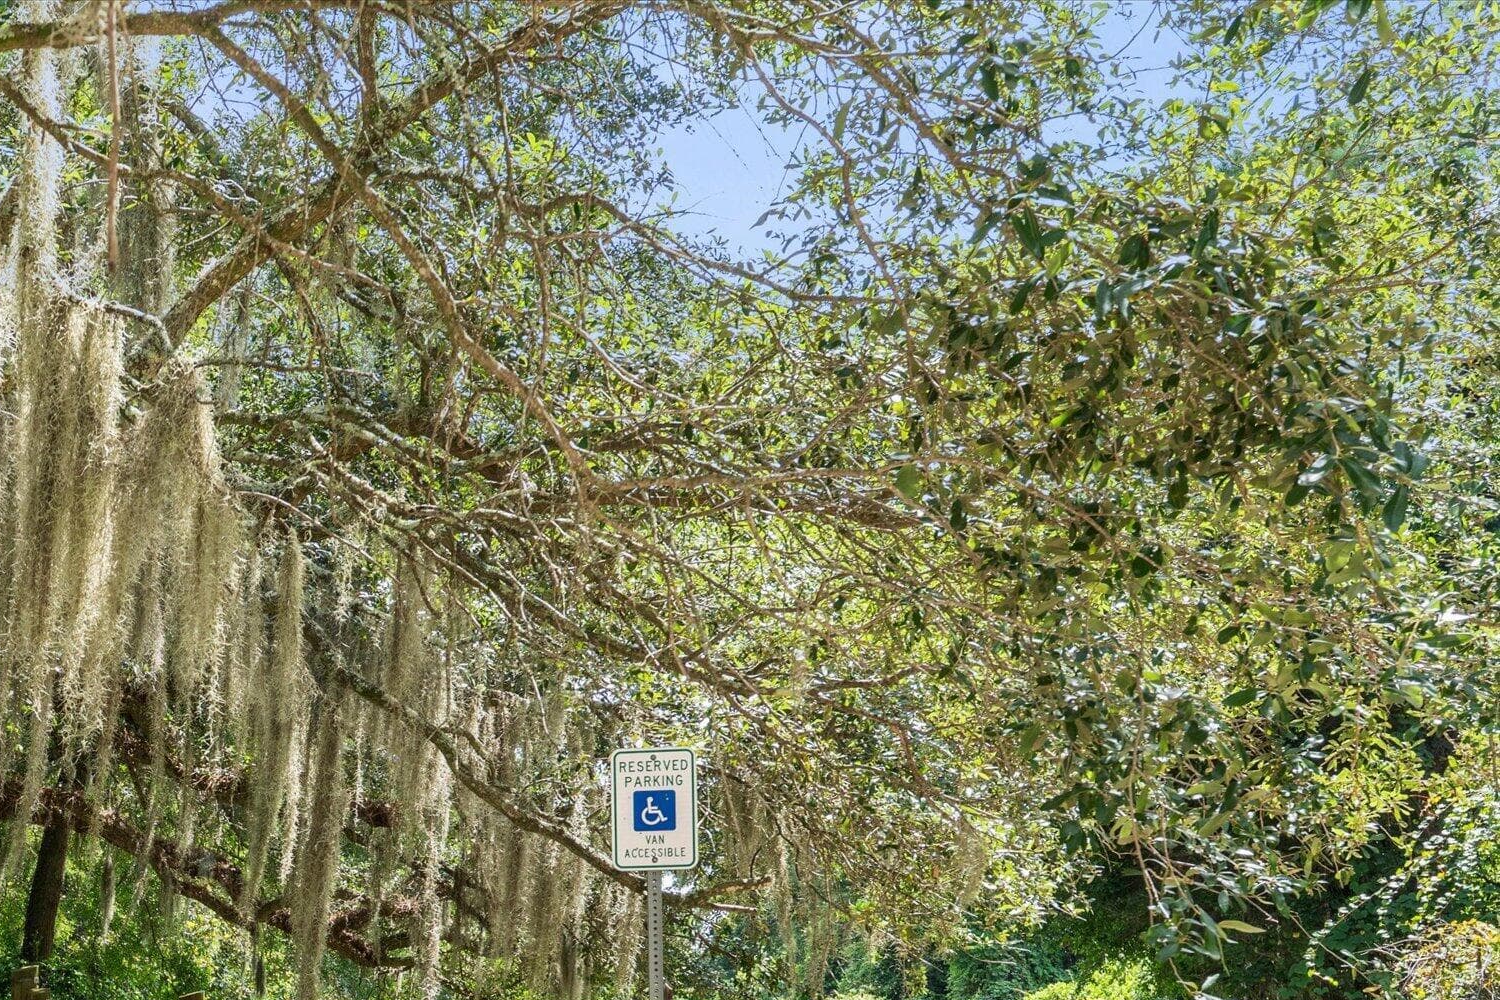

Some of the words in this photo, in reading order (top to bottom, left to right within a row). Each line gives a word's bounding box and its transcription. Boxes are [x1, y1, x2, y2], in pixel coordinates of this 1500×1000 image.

[619, 760, 688, 773] RESERVED
[624, 775, 683, 787] PARKING
[645, 835, 665, 844] VAN
[624, 847, 686, 858] ACCESSIBLE
